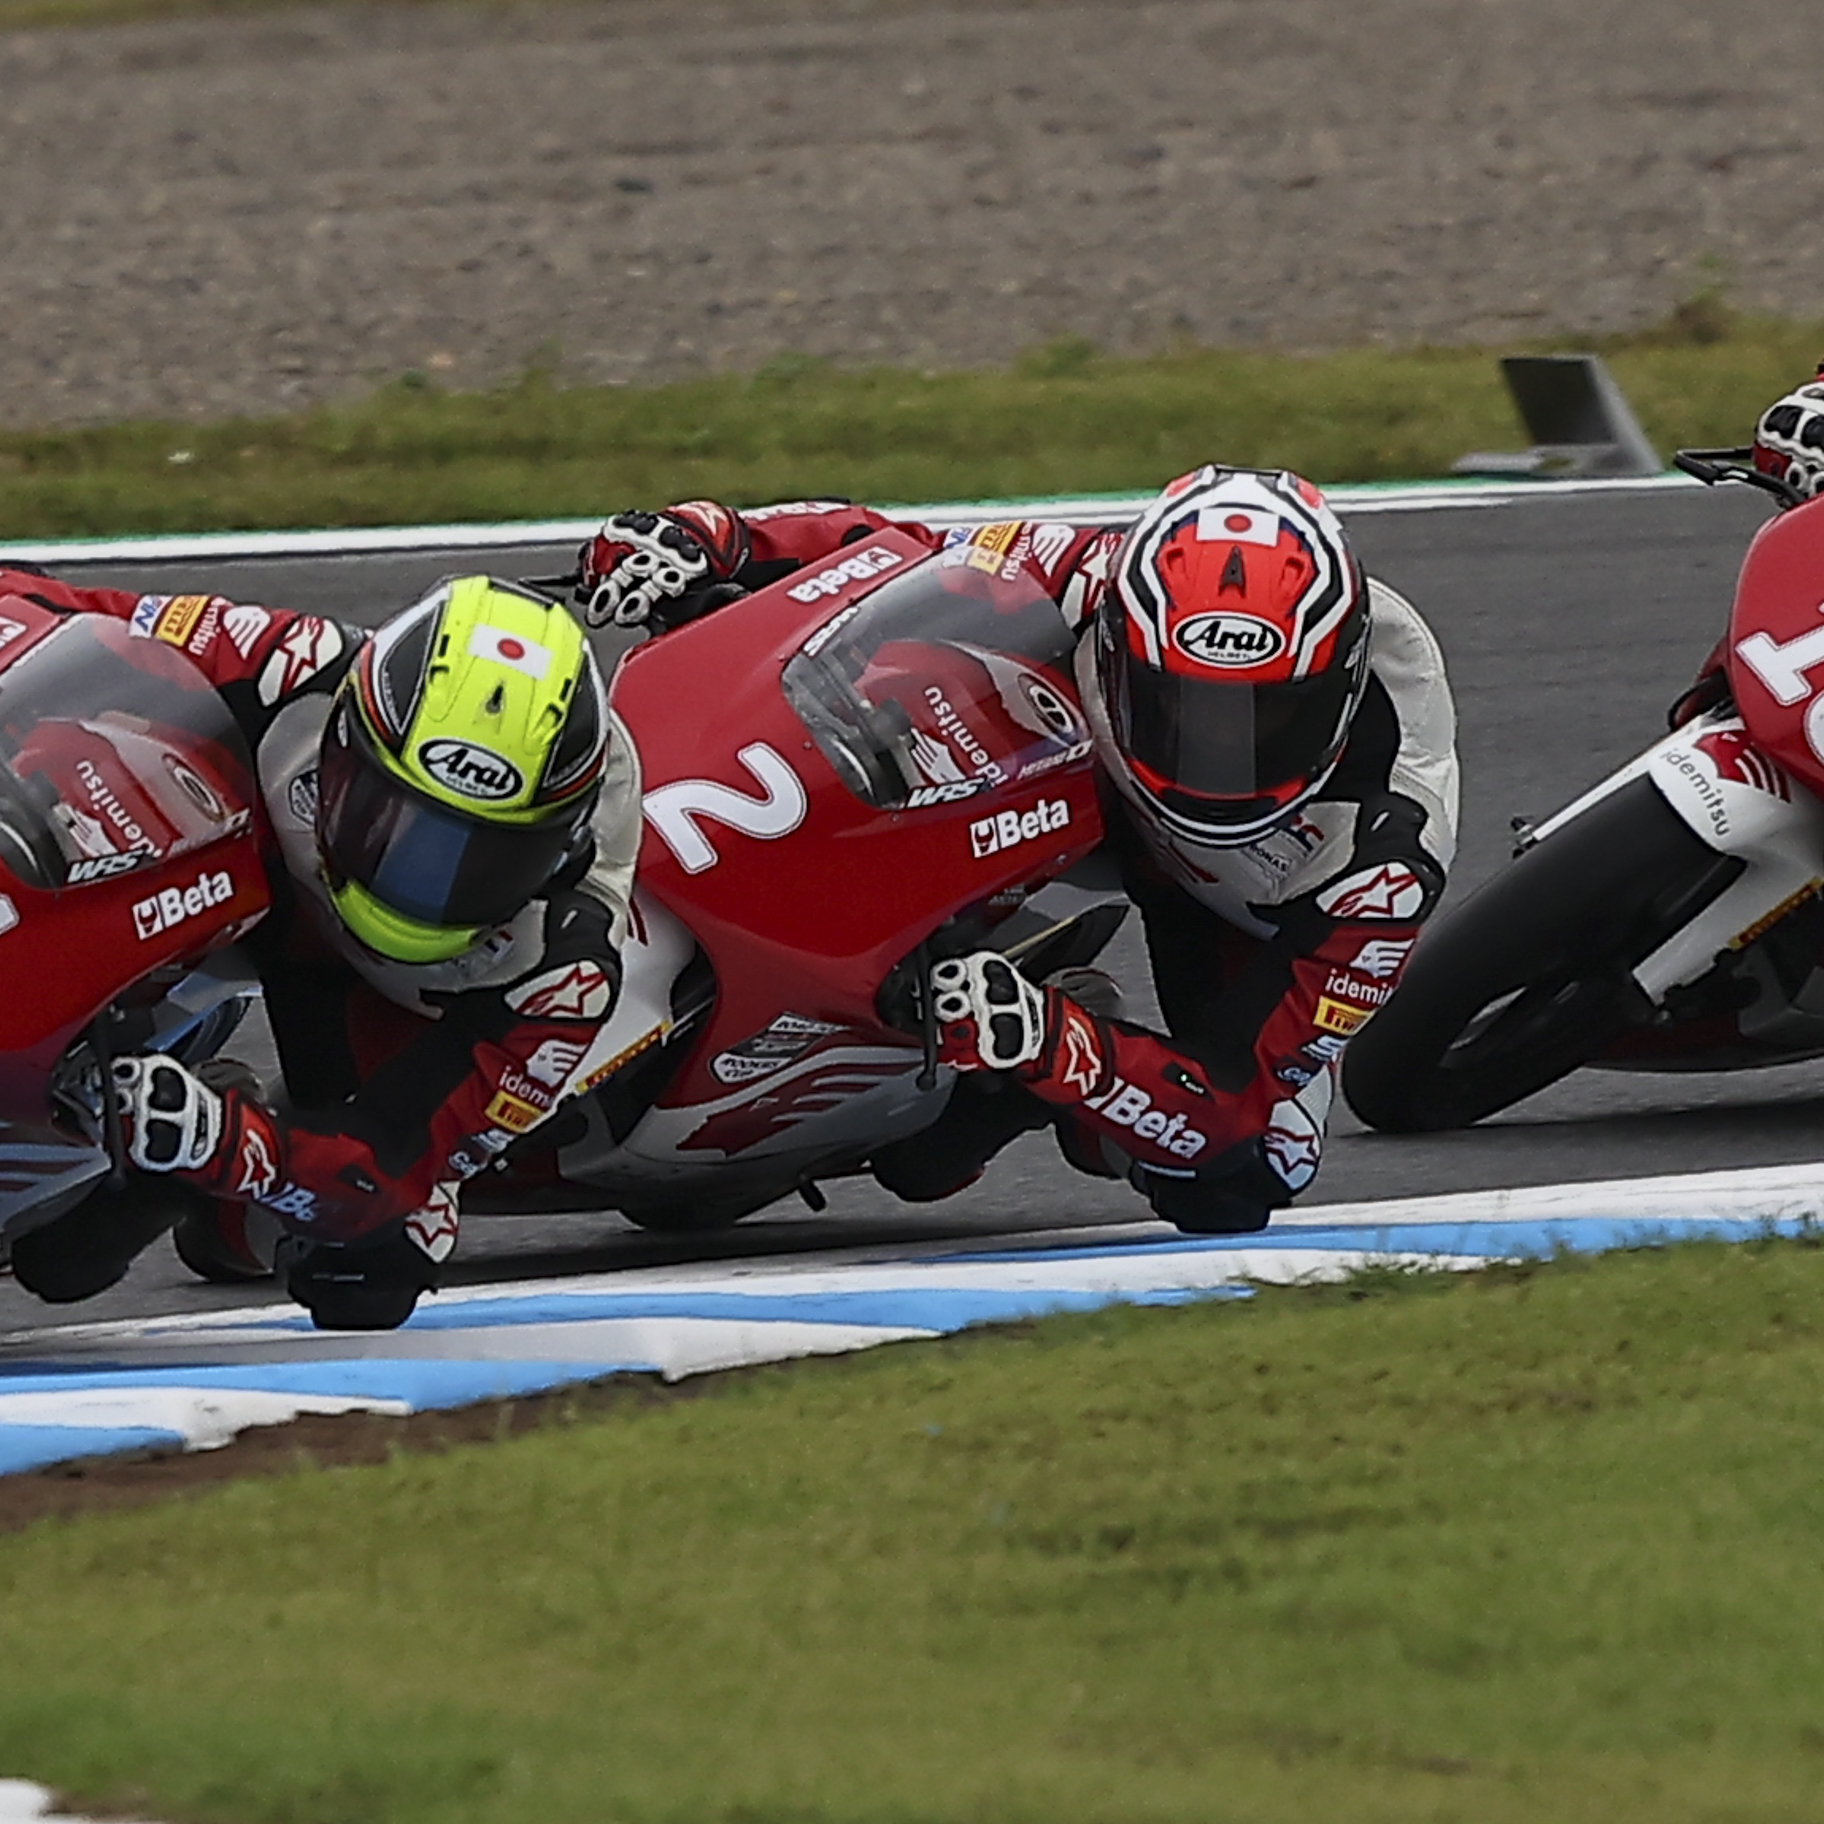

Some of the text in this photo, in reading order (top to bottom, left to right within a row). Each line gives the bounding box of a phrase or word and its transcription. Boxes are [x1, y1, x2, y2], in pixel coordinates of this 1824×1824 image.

[786, 553, 878, 602] Beta
[1182, 620, 1270, 652] Arai
[925, 686, 1010, 788] idemitsu
[426, 747, 512, 790] Arai
[907, 777, 986, 808] WRS
[1660, 746, 1732, 836] idemitsu
[642, 742, 808, 875] 2
[999, 798, 1069, 849] Beta
[68, 850, 141, 883] WRS
[164, 871, 234, 930] Beta
[1101, 1083, 1207, 1160] Beta
